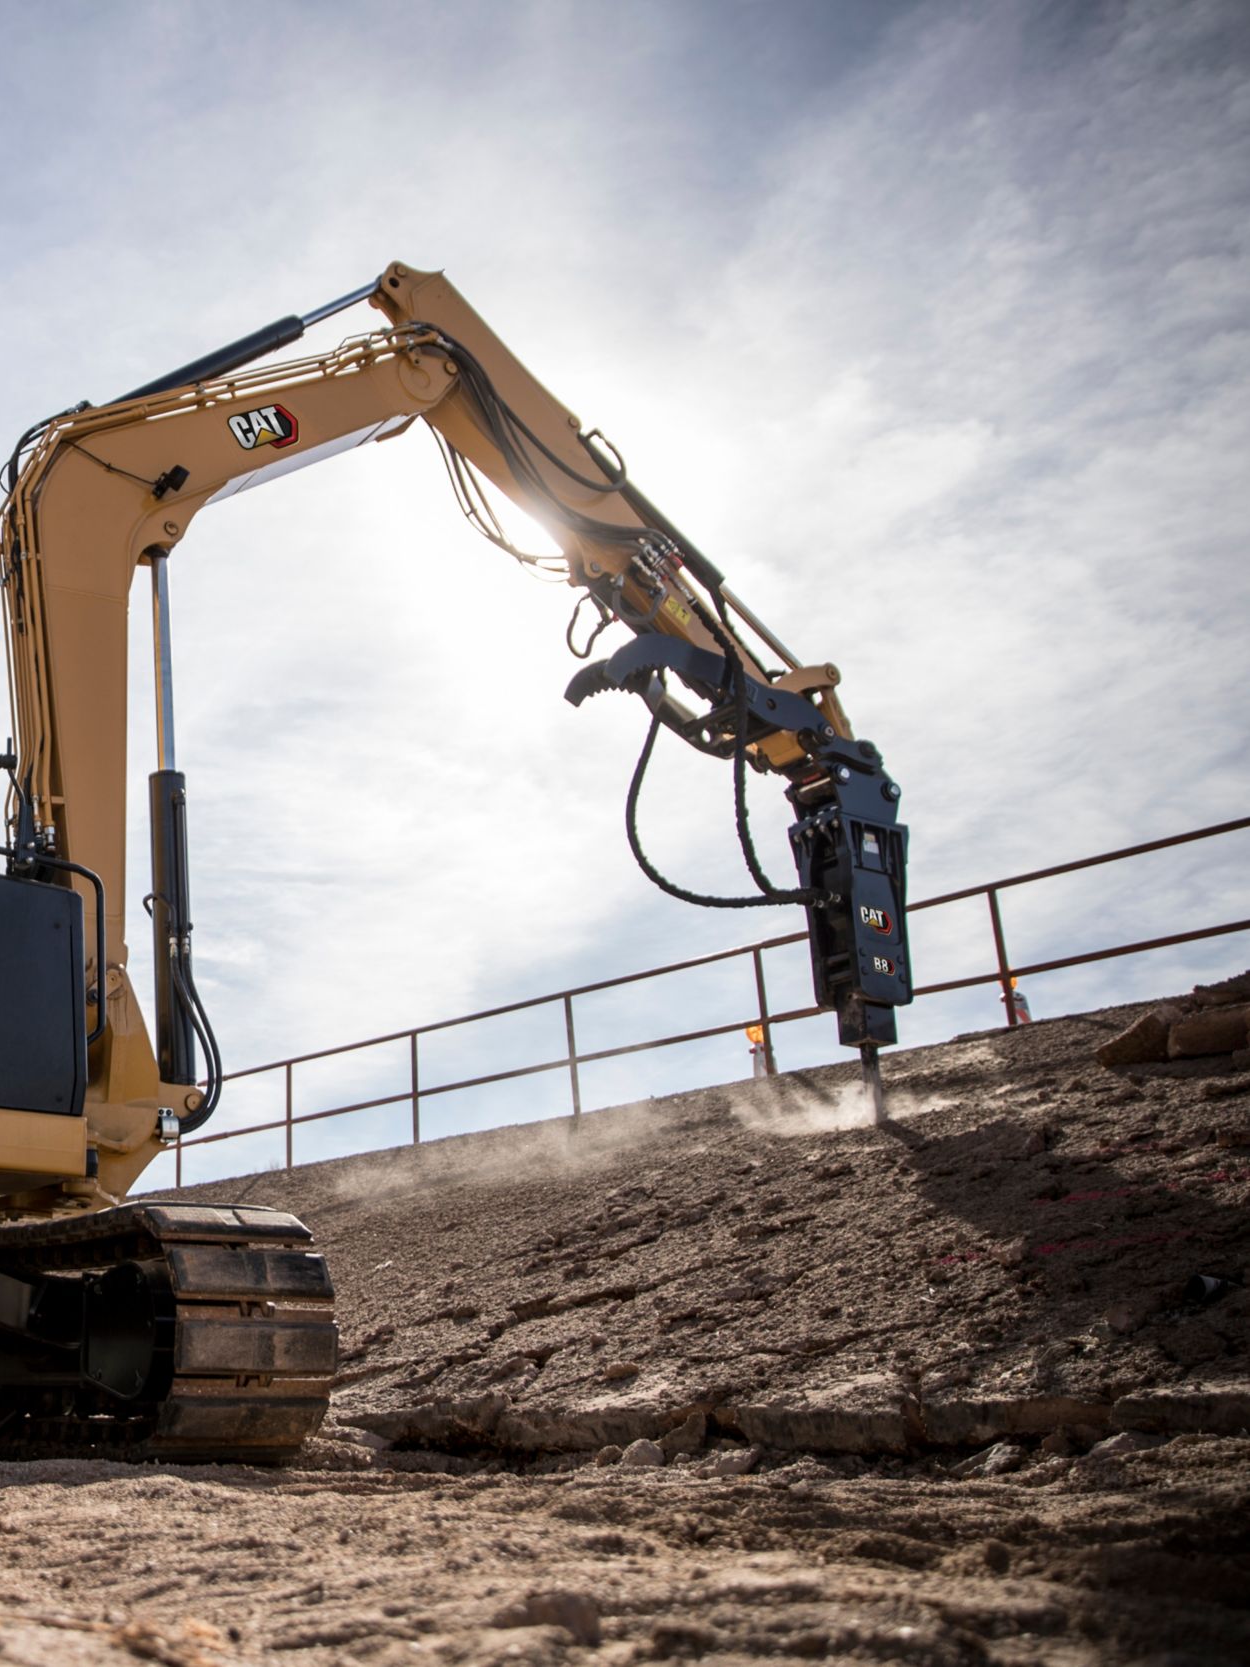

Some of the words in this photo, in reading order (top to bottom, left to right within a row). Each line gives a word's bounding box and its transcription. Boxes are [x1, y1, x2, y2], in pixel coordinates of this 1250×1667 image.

[228, 406, 285, 449] CAT
[860, 905, 884, 928] CAT
[873, 956, 889, 973] B8
